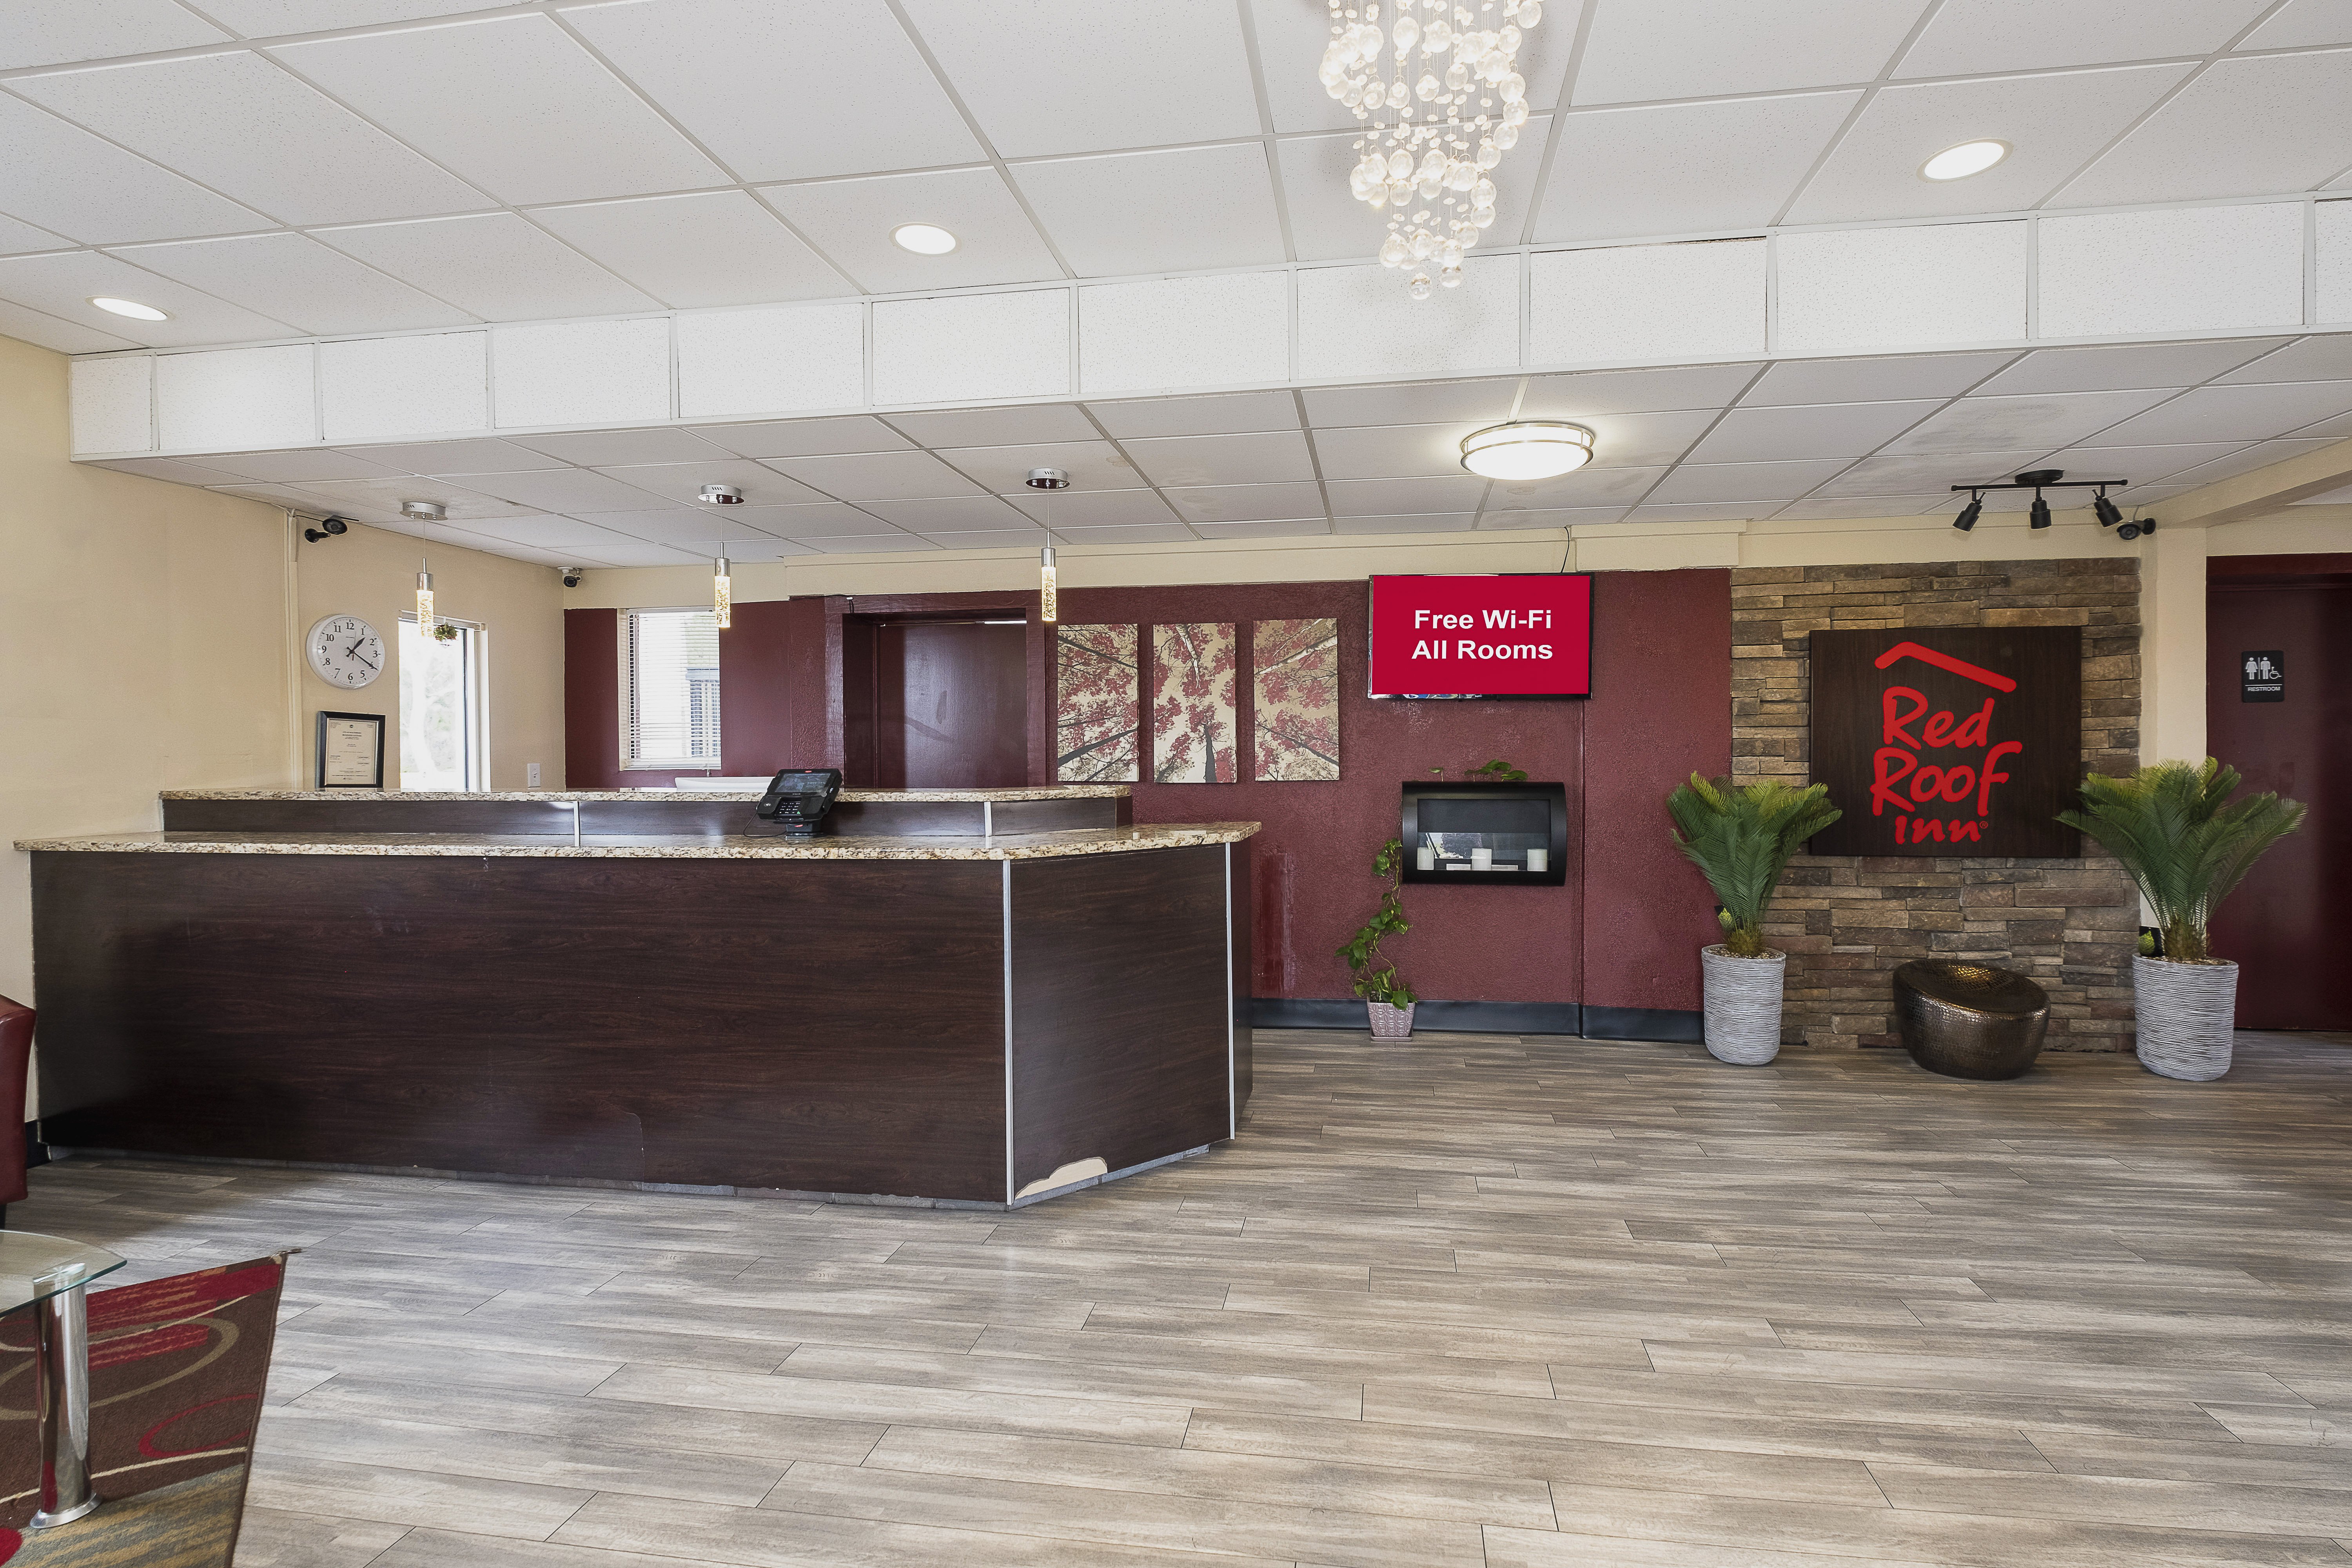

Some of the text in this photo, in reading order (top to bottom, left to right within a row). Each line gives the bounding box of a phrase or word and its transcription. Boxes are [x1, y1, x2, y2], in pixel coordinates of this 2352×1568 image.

[1415, 610, 1551, 629] Free Wi-Fi
[321, 645, 327, 653] 9
[1411, 640, 1553, 659] All Rooms
[334, 668, 341, 679] 7
[348, 672, 353, 681] 6
[360, 670, 365, 678] 5
[1882, 686, 1995, 750] Red
[1869, 741, 2023, 817] Roof
